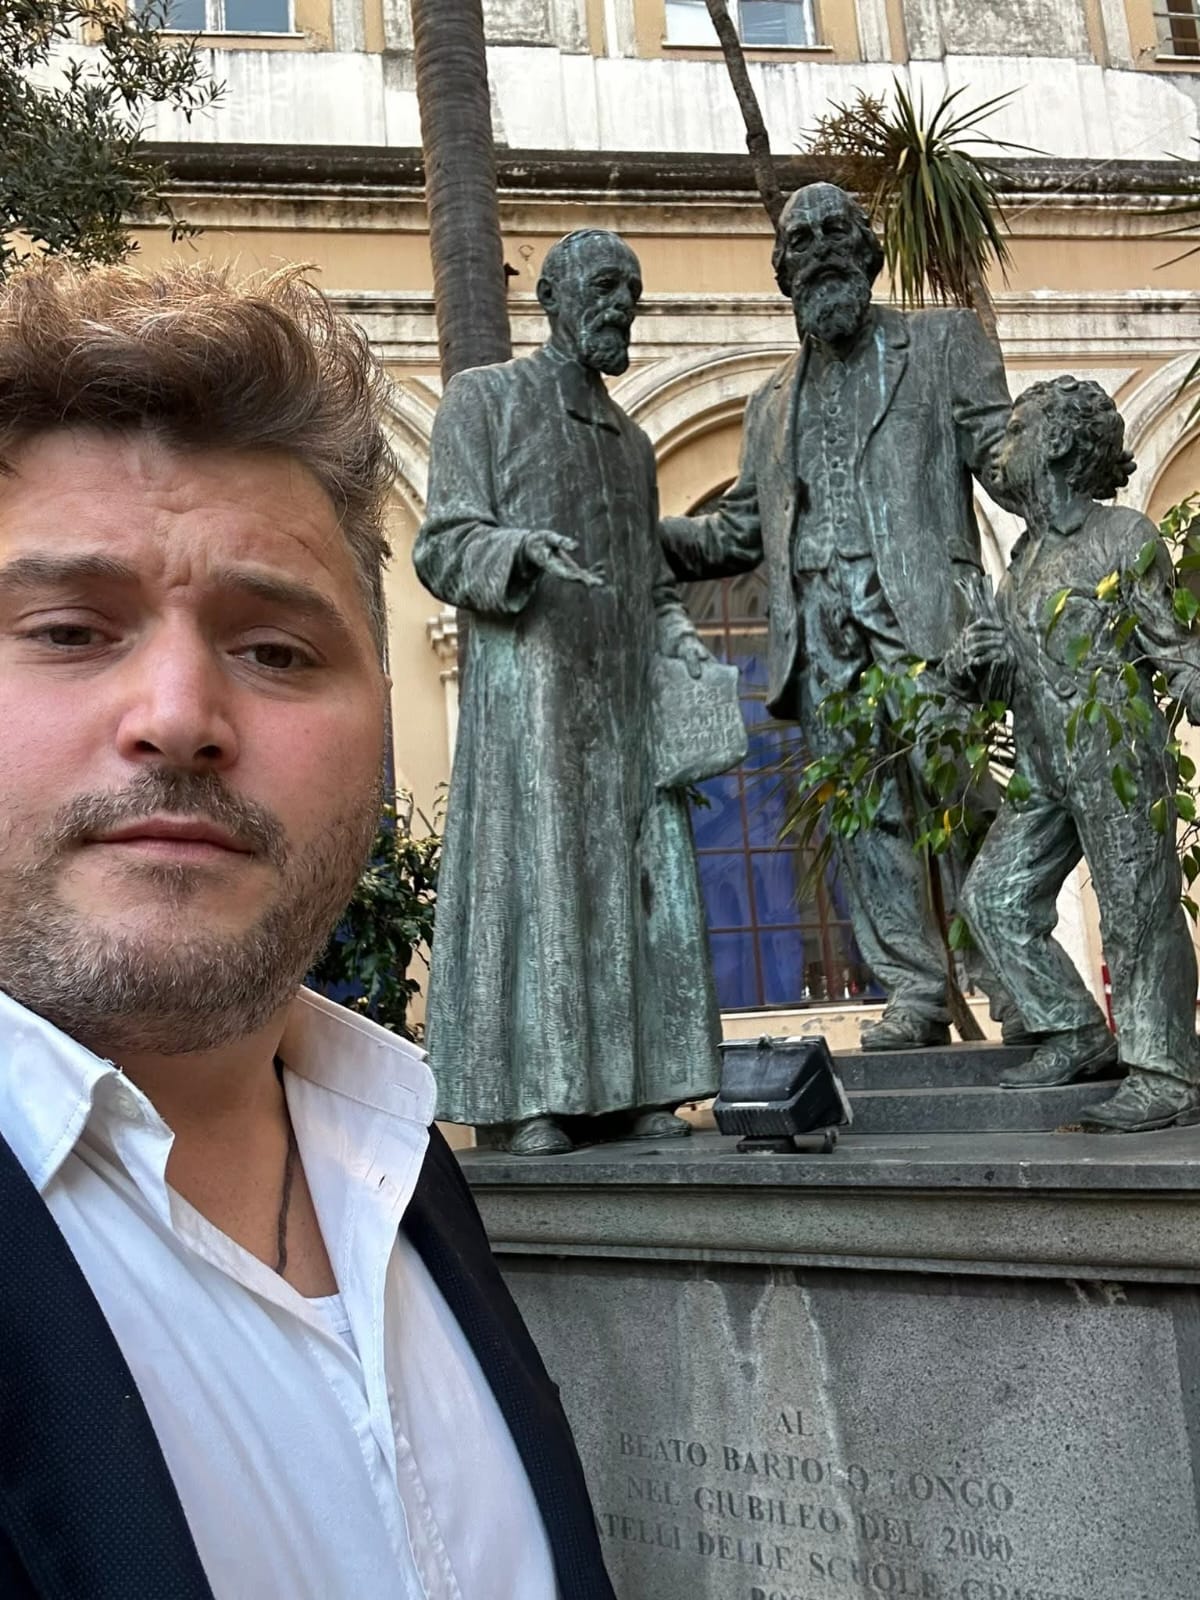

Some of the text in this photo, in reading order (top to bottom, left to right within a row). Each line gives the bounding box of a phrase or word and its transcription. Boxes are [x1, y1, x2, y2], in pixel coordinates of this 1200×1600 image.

[619, 1431, 707, 1467] BEATO
[775, 1411, 813, 1437] AL
[627, 1474, 1014, 1562] NEL GIUBILEO DEL 2000
[698, 1531, 793, 1572] DELLE
[808, 1552, 936, 1599] SCUOLE
